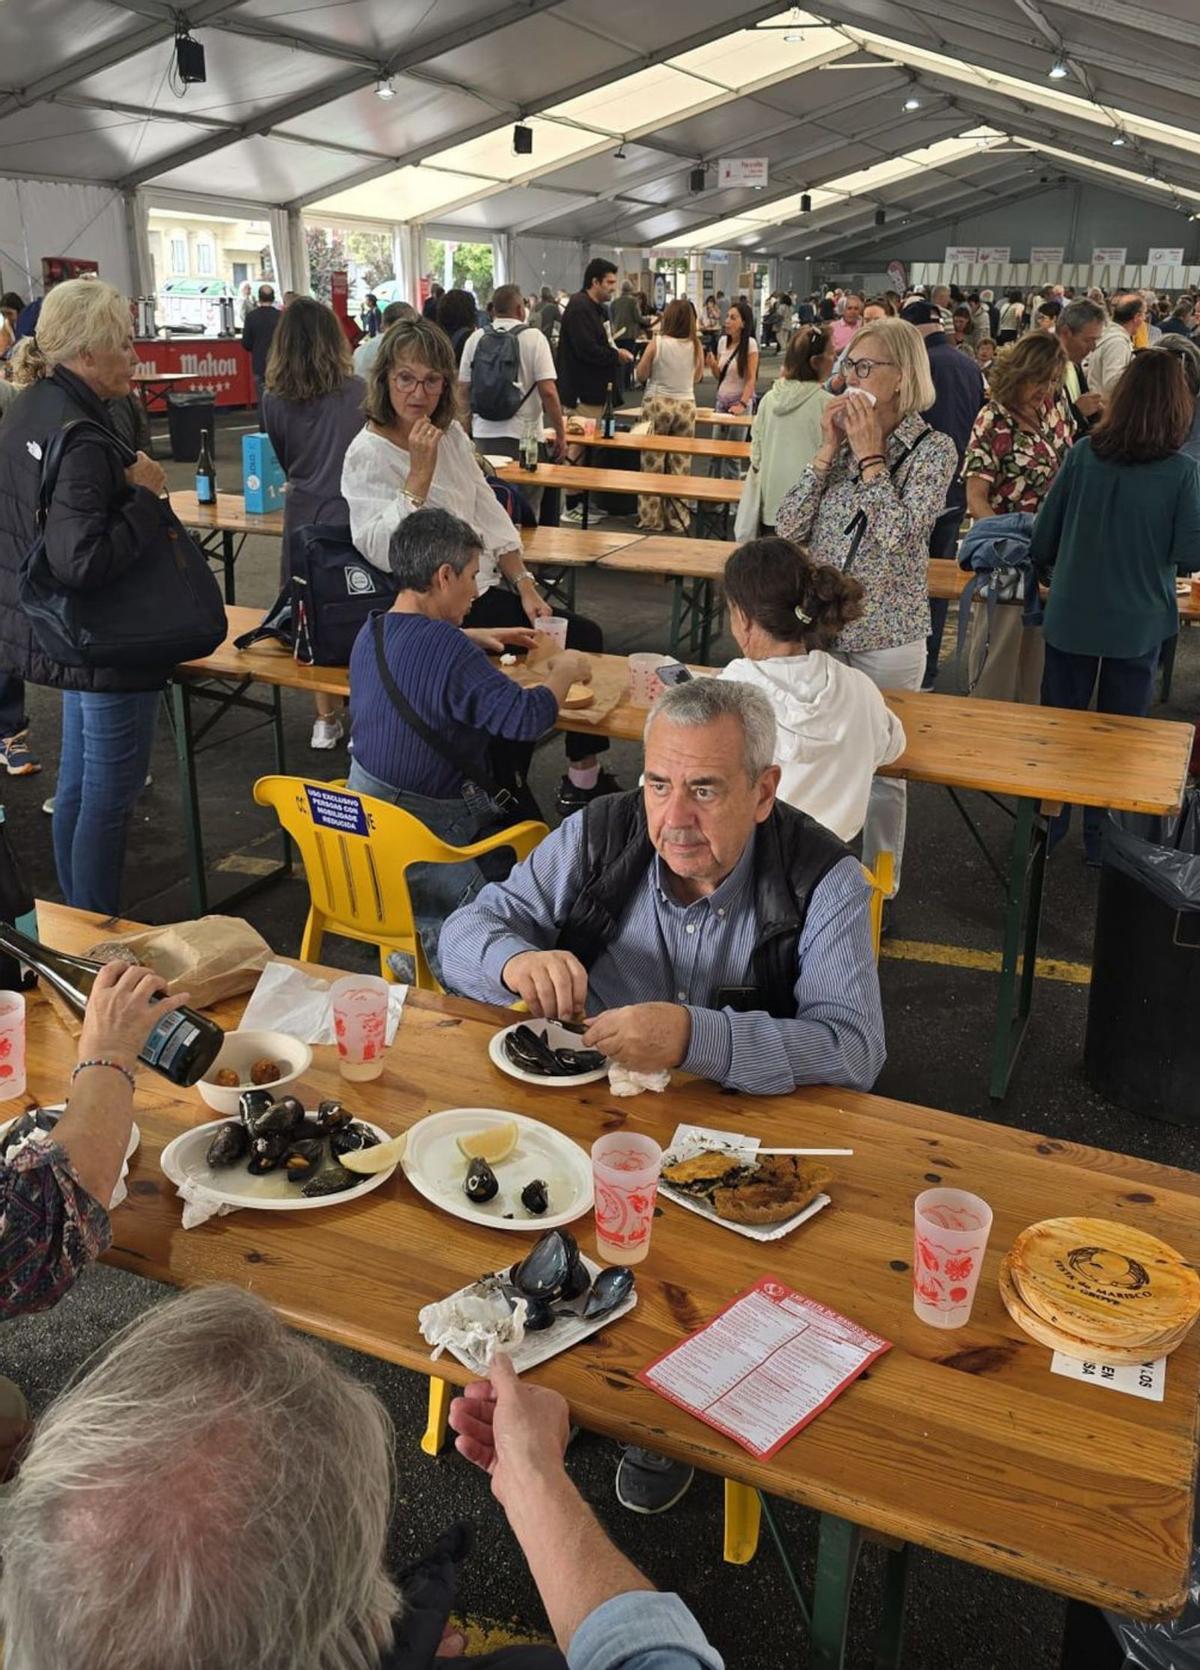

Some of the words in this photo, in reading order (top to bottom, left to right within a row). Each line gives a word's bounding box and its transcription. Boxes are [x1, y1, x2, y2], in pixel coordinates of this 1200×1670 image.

[180, 352, 237, 377] Mahou
[322, 793, 359, 807] EXCLUSIVO
[343, 805, 359, 815] CON
[322, 815, 357, 830] REDUCIDA
[1095, 1287, 1153, 1299] MARISCO
